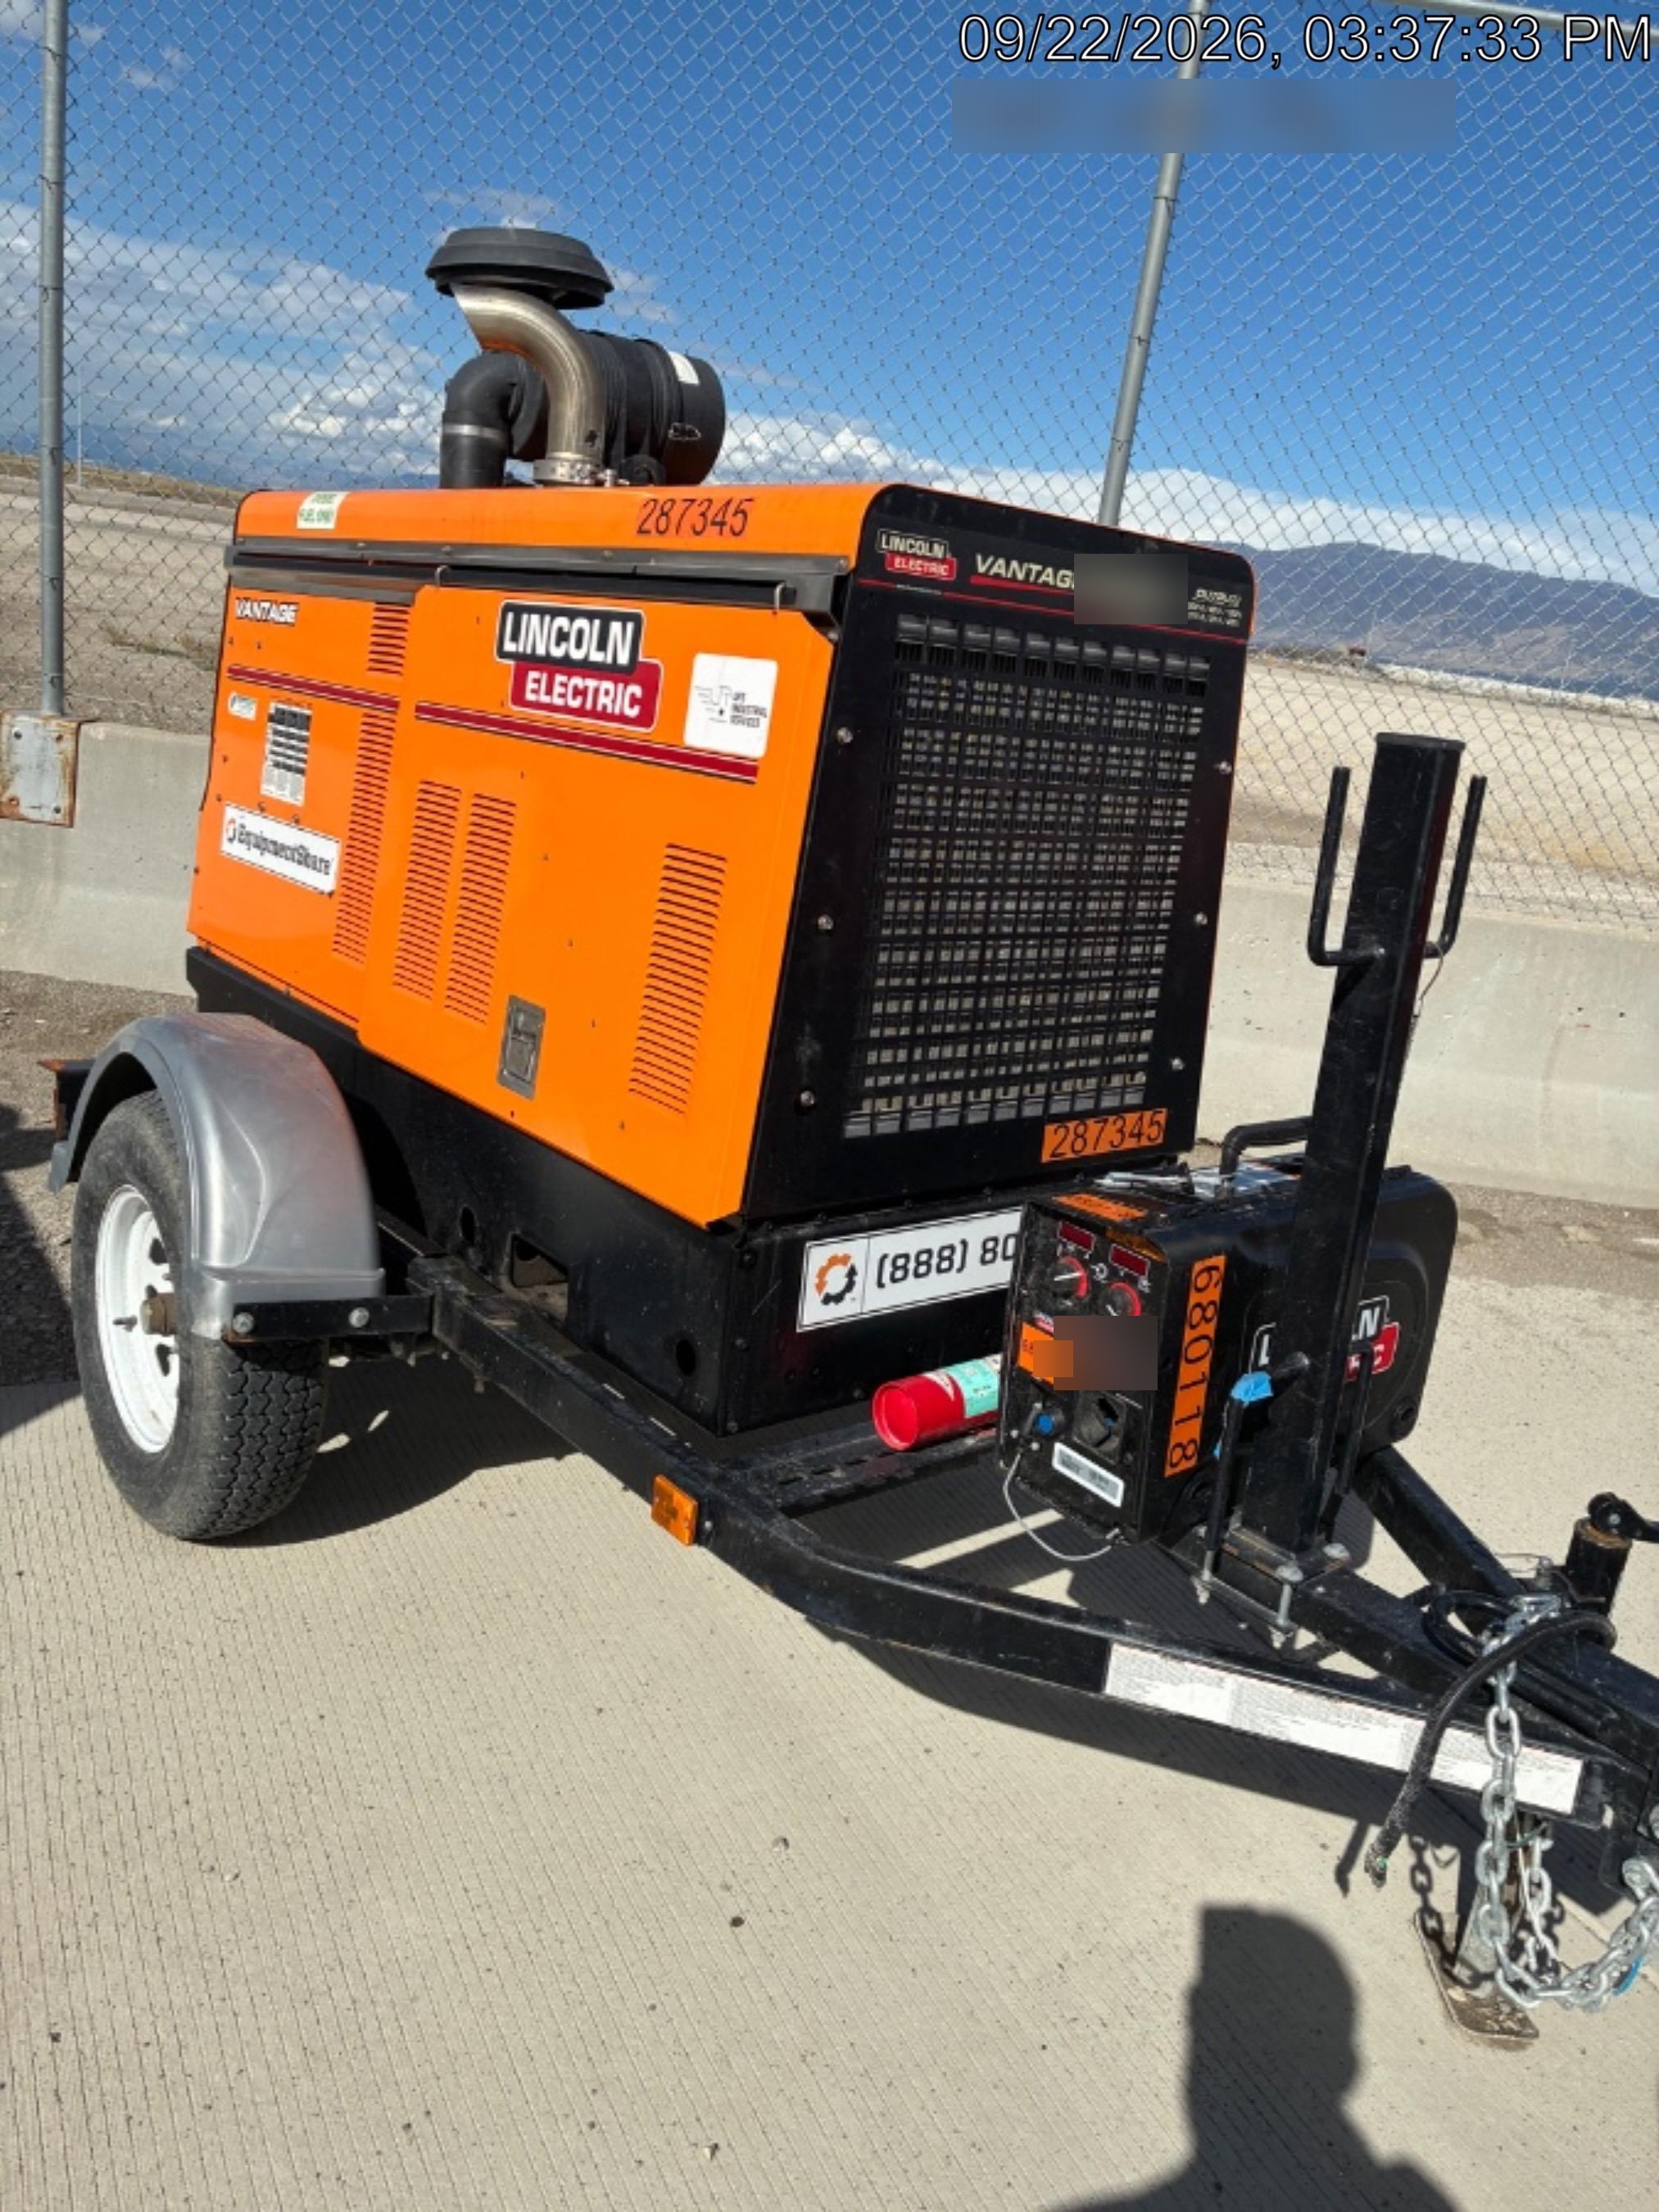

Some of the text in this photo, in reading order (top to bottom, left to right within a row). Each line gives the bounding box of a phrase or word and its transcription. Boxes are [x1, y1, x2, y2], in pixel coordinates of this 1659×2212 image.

[637, 497, 755, 537] 287345
[882, 533, 945, 558] LINCOLN
[893, 557, 950, 577] ELECTRIC
[975, 552, 1074, 589] VANTAG
[234, 597, 300, 626] VANTAGE
[503, 611, 635, 666] LINCOLN
[524, 670, 642, 718] ELECTRIC
[238, 823, 330, 876] EquipmentShare
[1049, 1110, 1164, 1158] 287345
[877, 1238, 969, 1289] (888)
[1169, 1264, 1222, 1468] 680118
